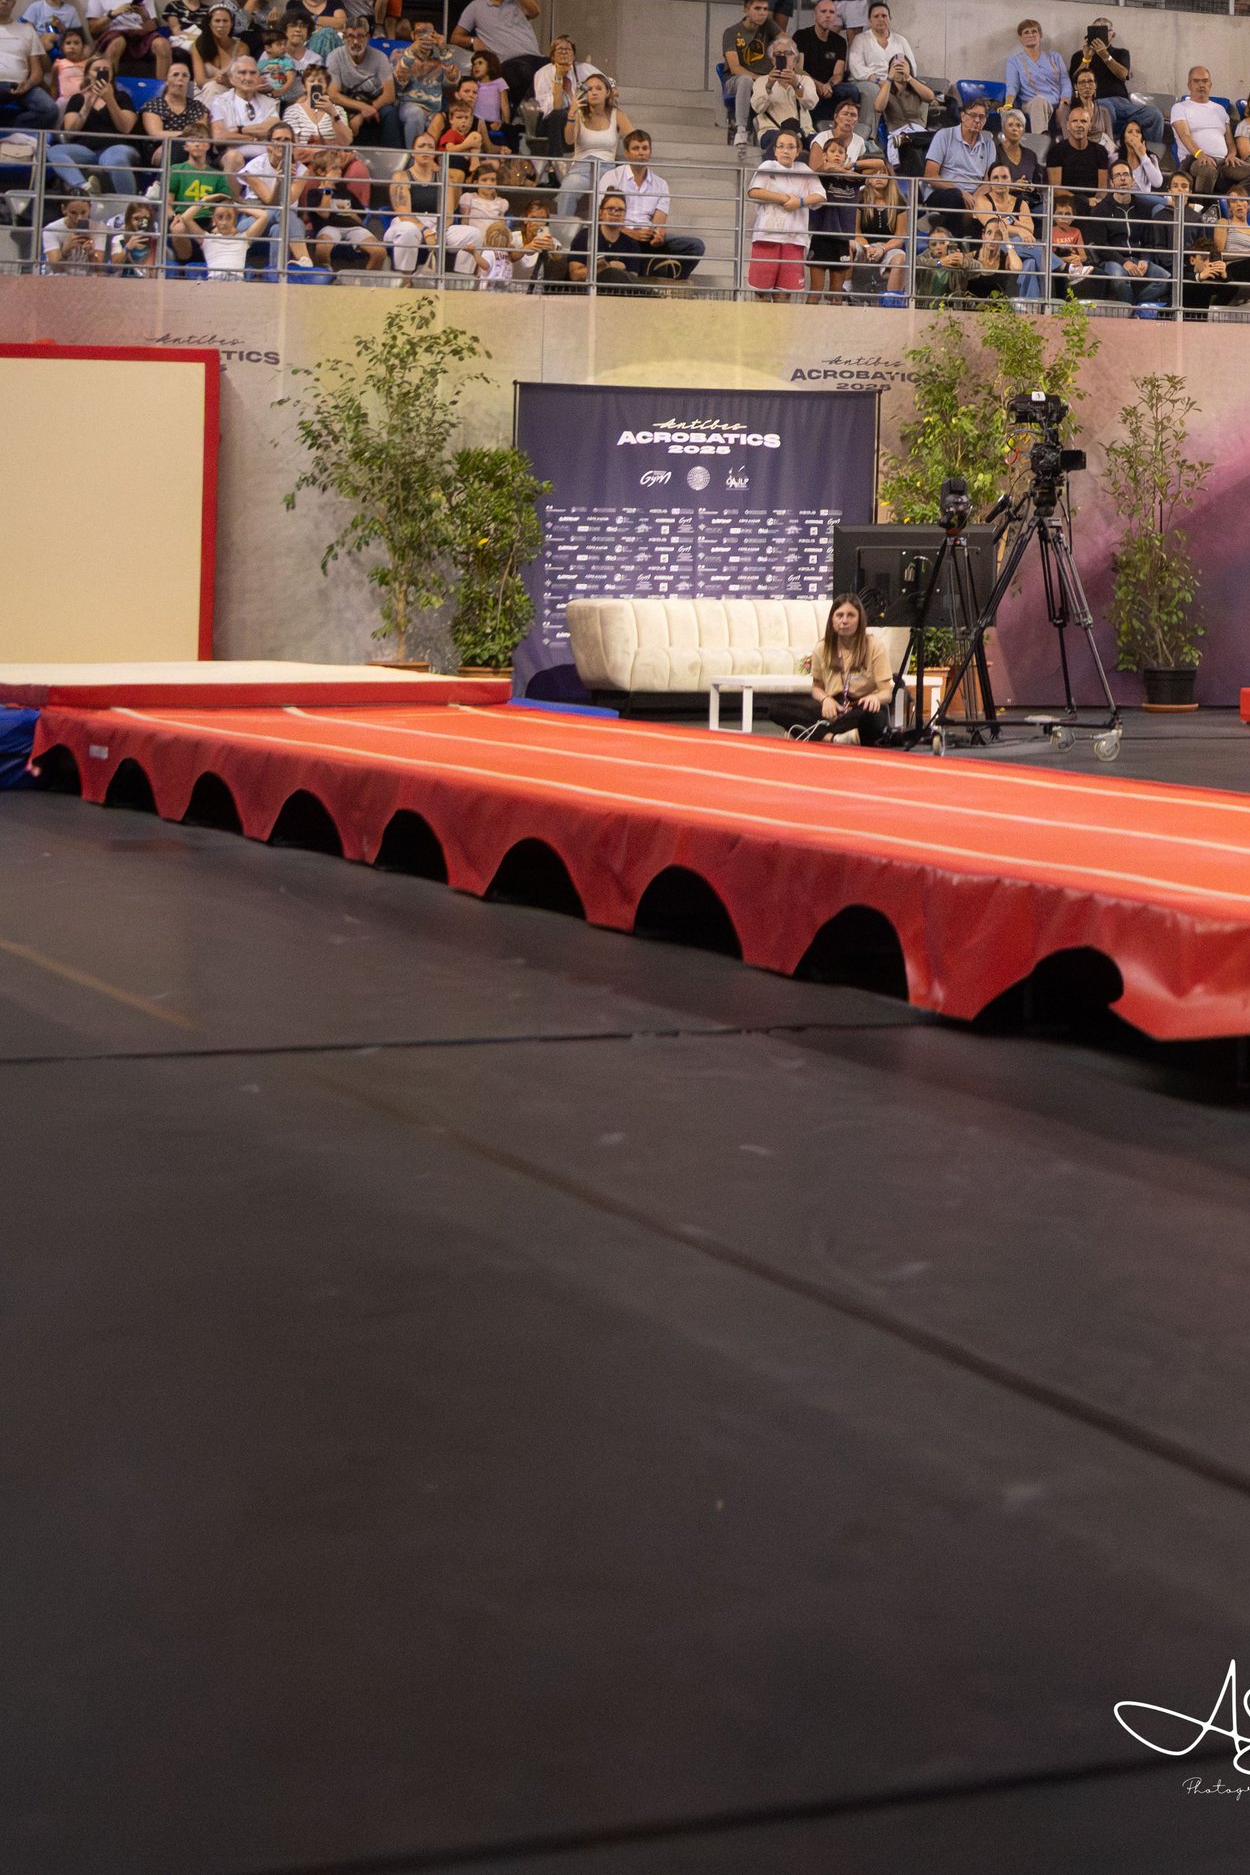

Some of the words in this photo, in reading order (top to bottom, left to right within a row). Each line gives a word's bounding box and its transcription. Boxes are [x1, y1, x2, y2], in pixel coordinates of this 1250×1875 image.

[821, 355, 904, 367] Antibes
[790, 368, 922, 384] ACROBATIC
[652, 418, 748, 431] Antibes
[616, 431, 782, 448] ACROBATICS
[667, 445, 731, 455] 2025
